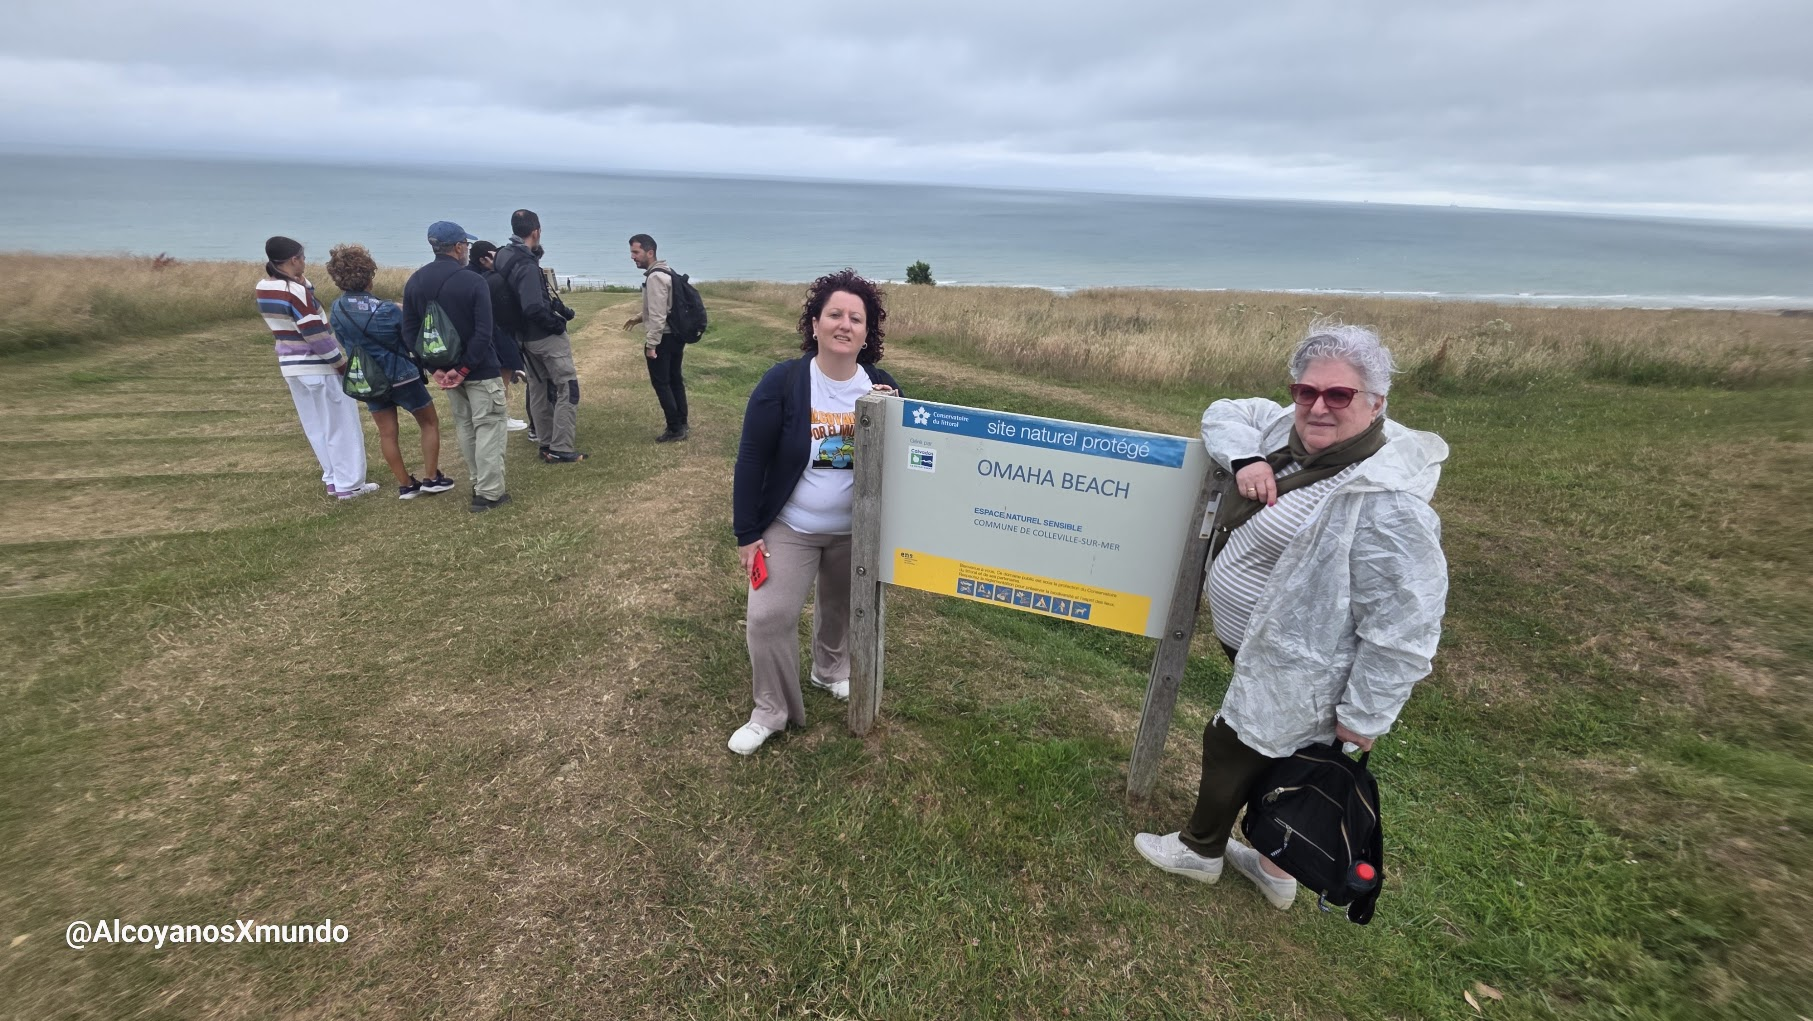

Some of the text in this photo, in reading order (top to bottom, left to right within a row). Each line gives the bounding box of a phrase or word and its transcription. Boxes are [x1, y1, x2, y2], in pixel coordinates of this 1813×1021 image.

[933, 411, 969, 422] Conservatoire
[941, 420, 959, 428] littoral
[988, 420, 1150, 459] site naturel protégé
[978, 460, 1130, 499] OMAHA BEACH
[974, 508, 1082, 532] ESPACE NATUREL SENSIBLE
[974, 518, 1018, 532] COMMUNE
[1032, 529, 1120, 551] COLLEVILLE-SUR-MER
